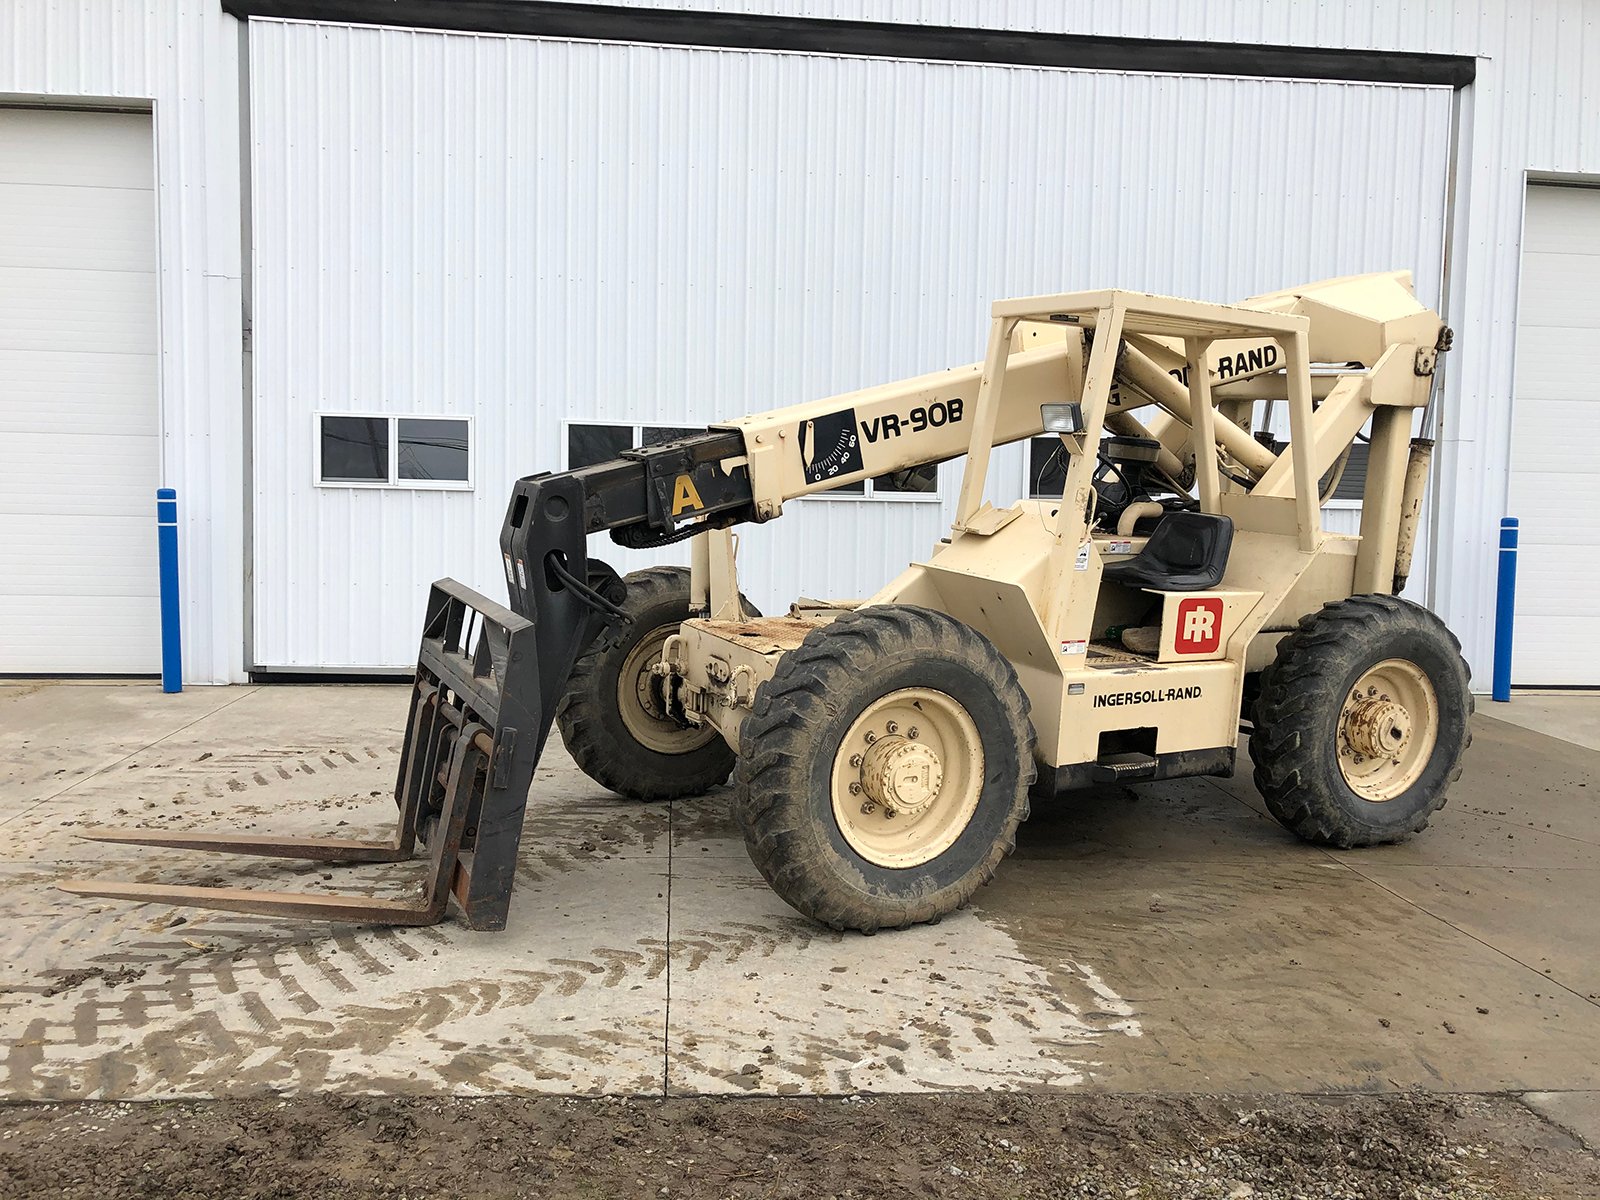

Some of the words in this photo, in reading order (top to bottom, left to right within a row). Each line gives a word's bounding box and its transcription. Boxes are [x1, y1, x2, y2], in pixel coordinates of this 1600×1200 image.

[860, 398, 963, 443] VR-90B
[814, 473, 821, 481] 0
[827, 464, 839, 476] 20
[840, 451, 850, 464] 40
[848, 434, 857, 448] 60
[672, 474, 704, 516] A
[1093, 686, 1202, 708] INGERSOLL-RAND
